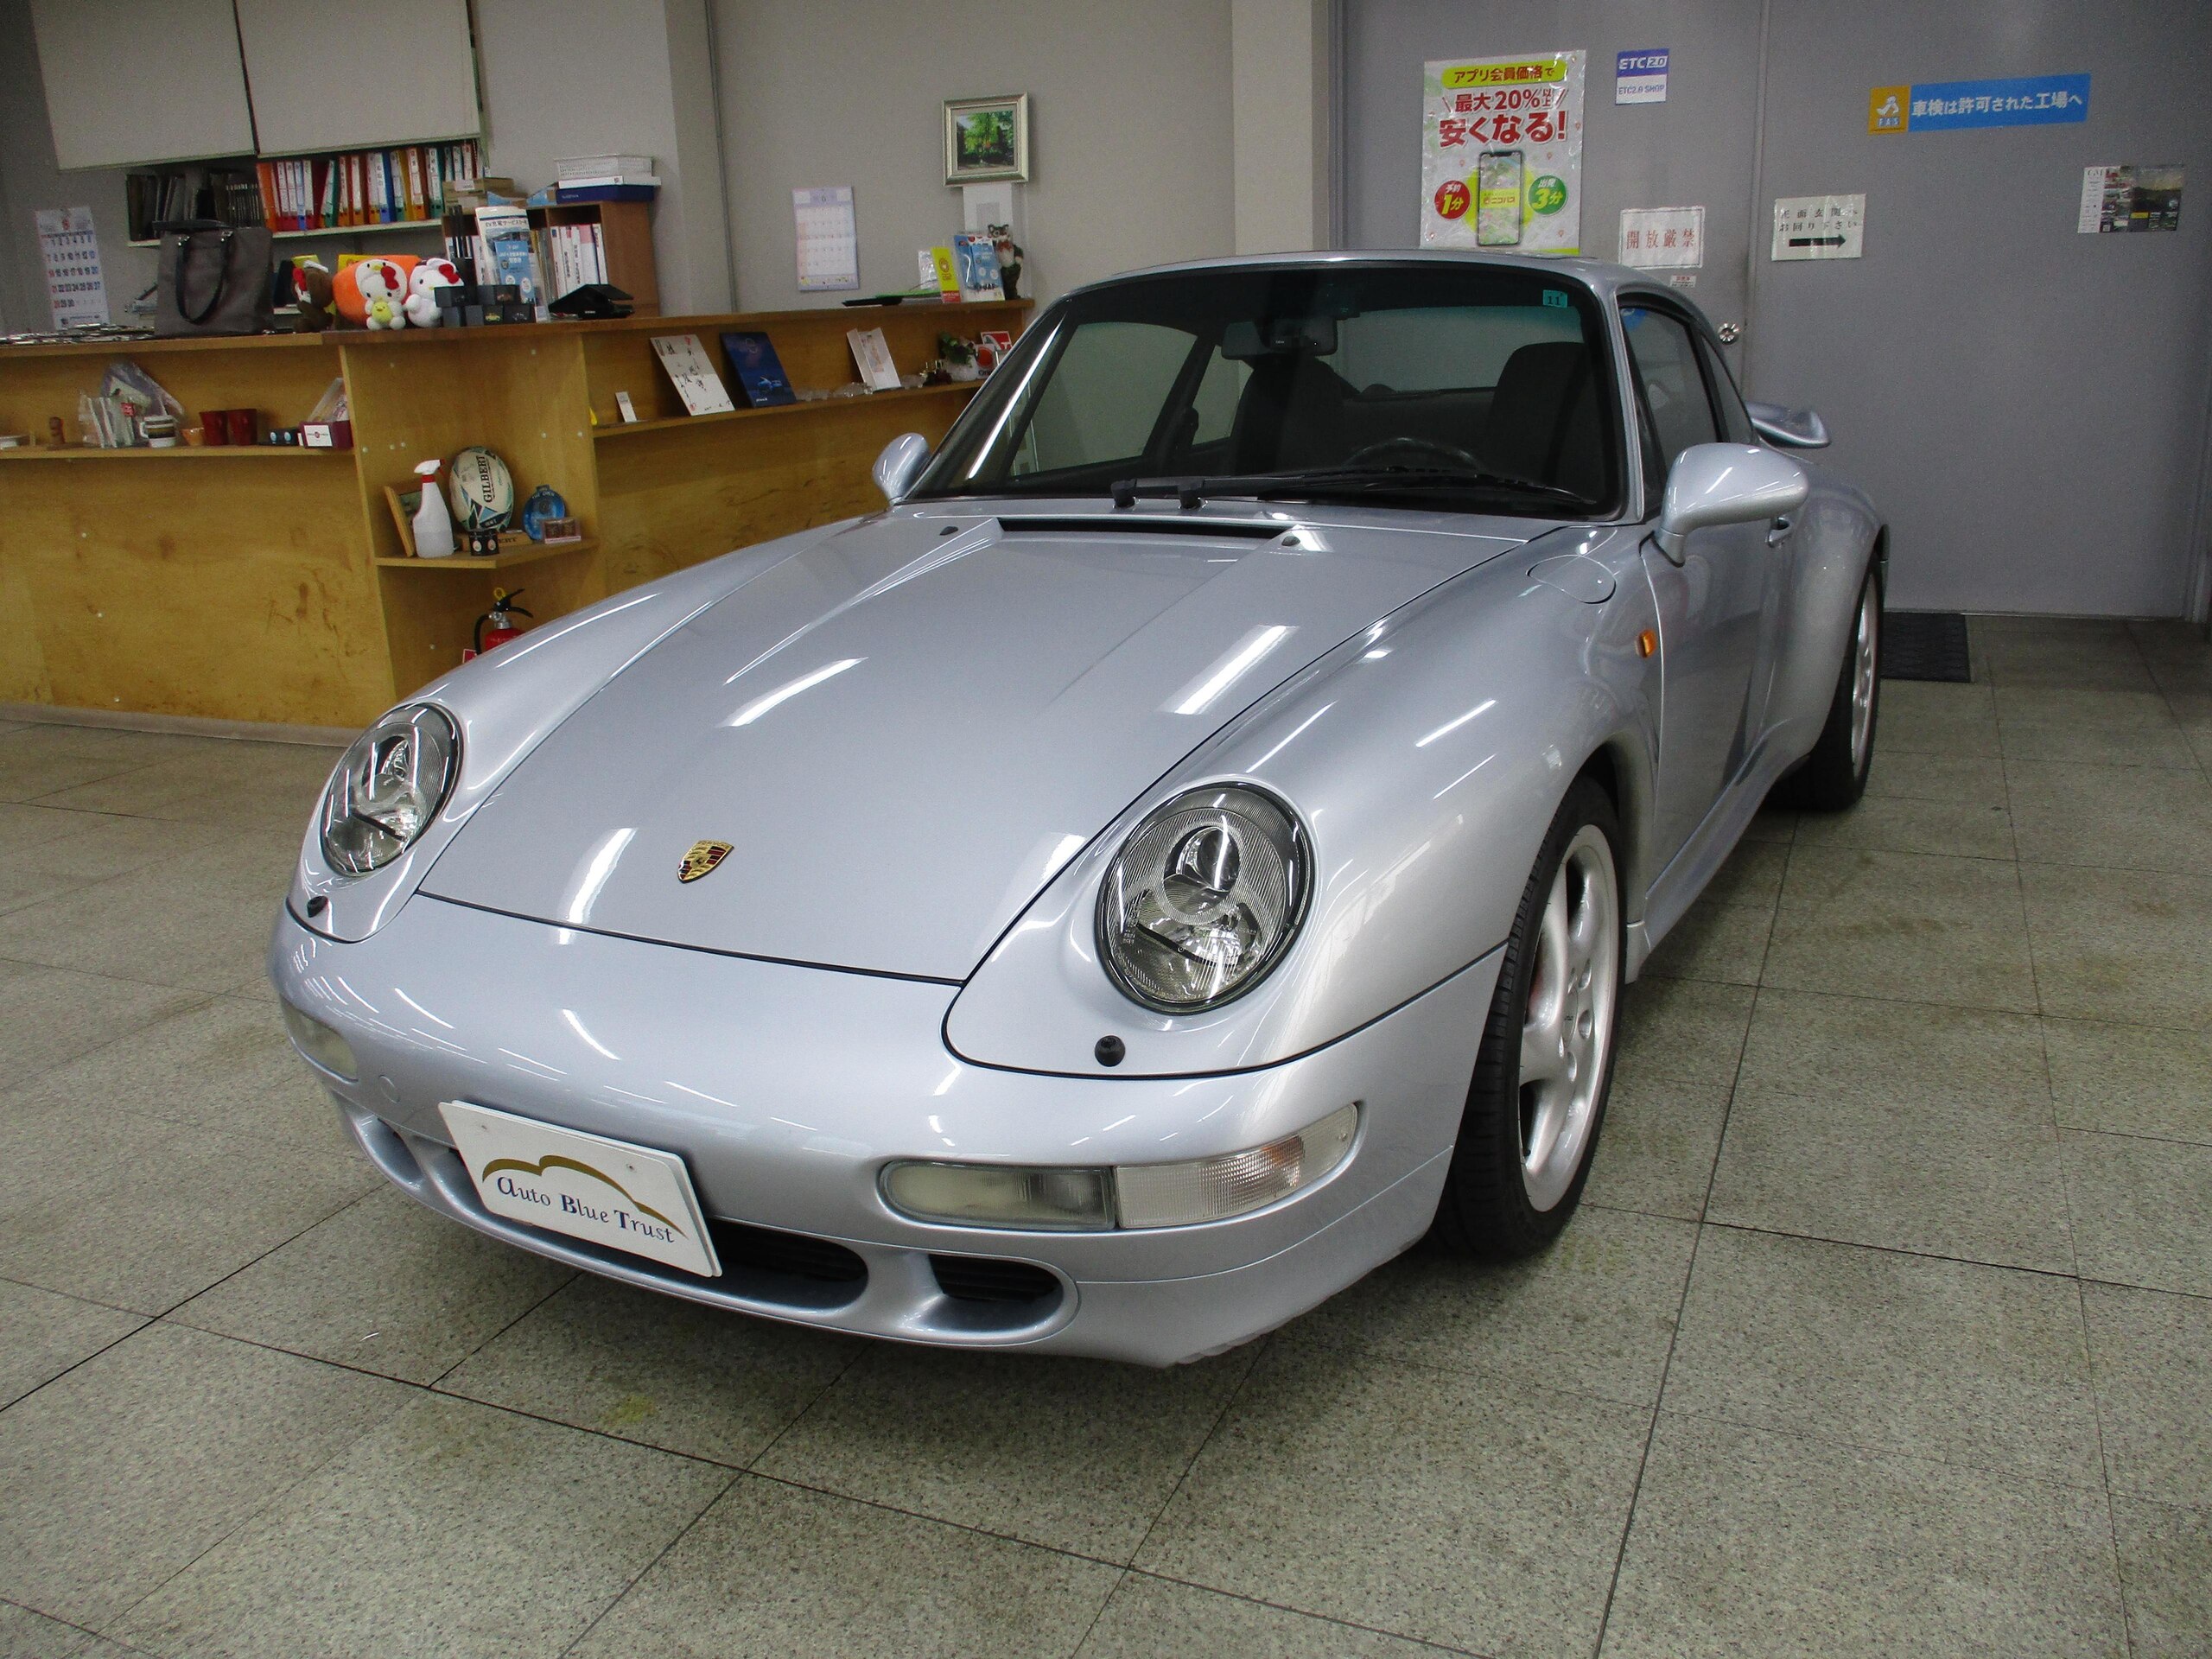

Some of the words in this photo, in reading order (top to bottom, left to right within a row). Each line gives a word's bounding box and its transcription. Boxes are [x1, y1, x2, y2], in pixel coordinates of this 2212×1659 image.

[1454, 66, 1555, 83] アプリ会員価格で
[1911, 91, 2083, 118] 車検は許可された工場へ
[1441, 194, 1464, 215] 1分
[1530, 188, 1563, 209] 3分
[1626, 228, 1694, 249] 開放厳禁
[1548, 296, 1560, 305] 11
[476, 455, 493, 503] GILBERT
[560, 1192, 608, 1224] Blue
[614, 1210, 675, 1243] Trust
